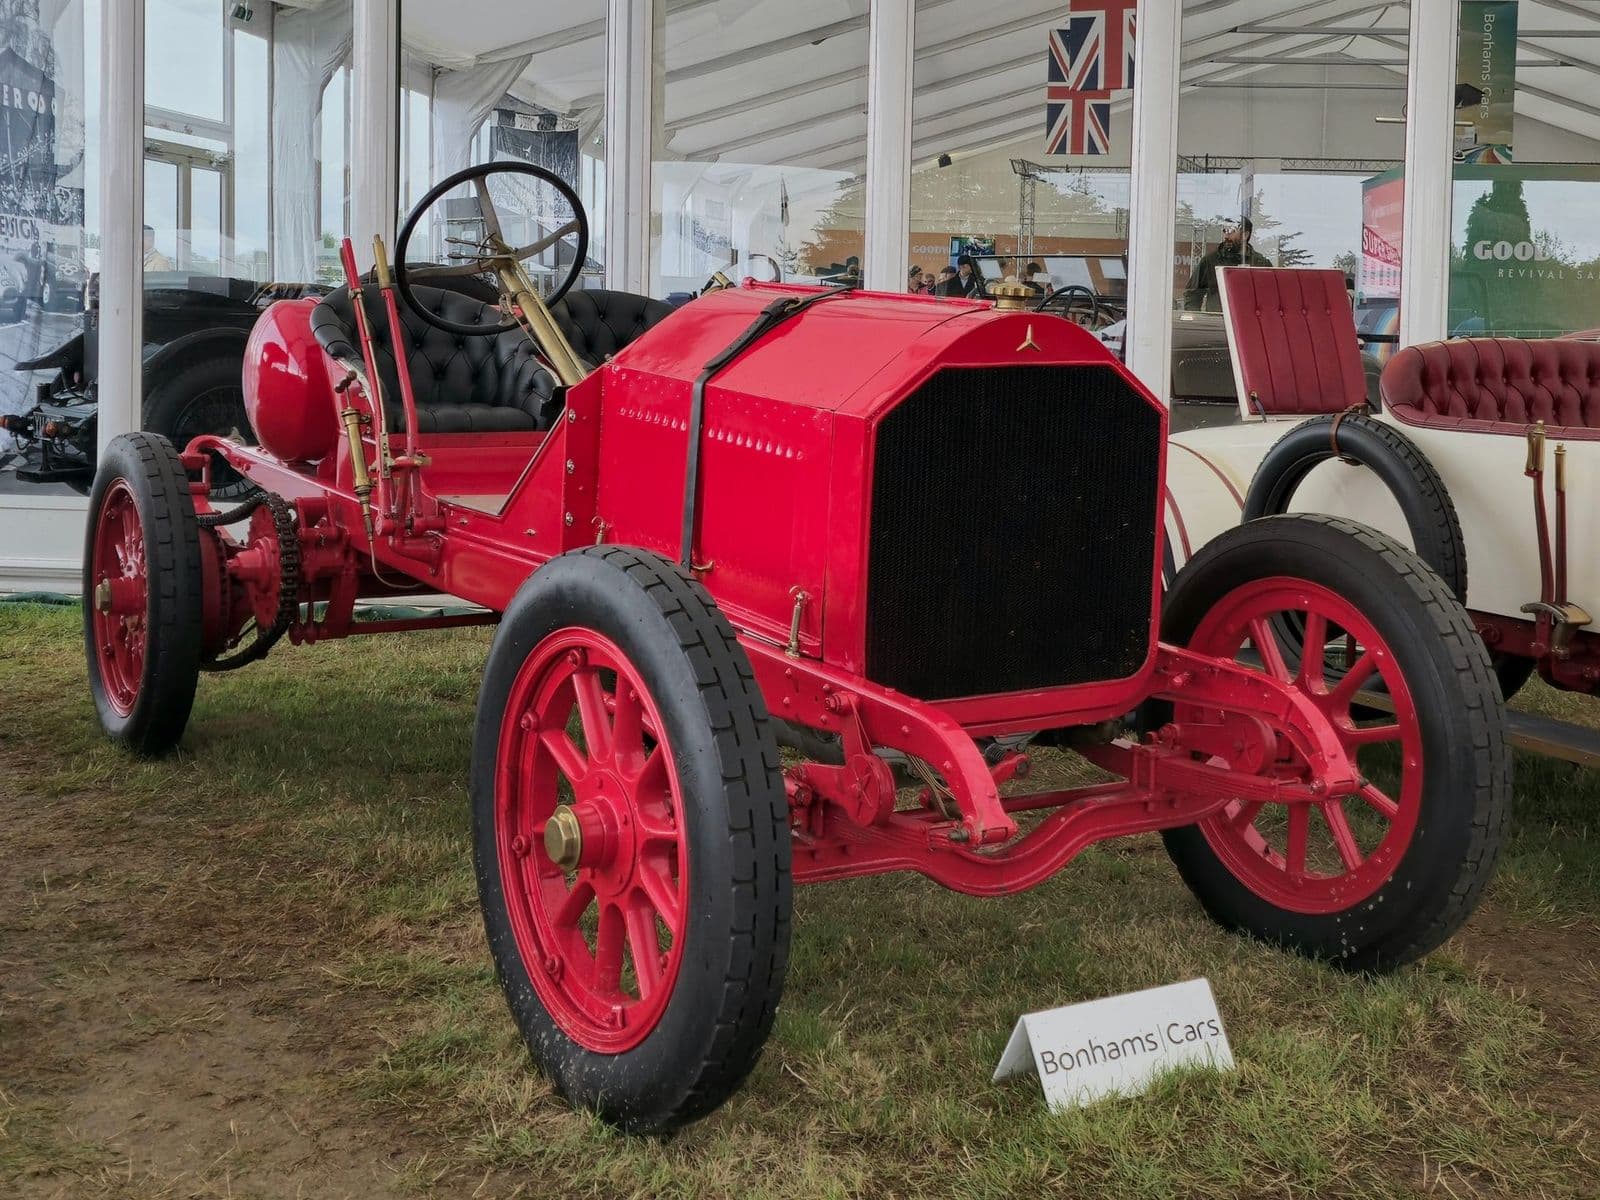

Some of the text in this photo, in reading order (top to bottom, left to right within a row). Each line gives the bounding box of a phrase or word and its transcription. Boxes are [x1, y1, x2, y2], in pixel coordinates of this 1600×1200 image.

[1480, 14, 1495, 119] Bonhams Cars
[1498, 268, 1600, 280] REVIVAL SA
[1040, 1018, 1220, 1075] Bonhams Cars
